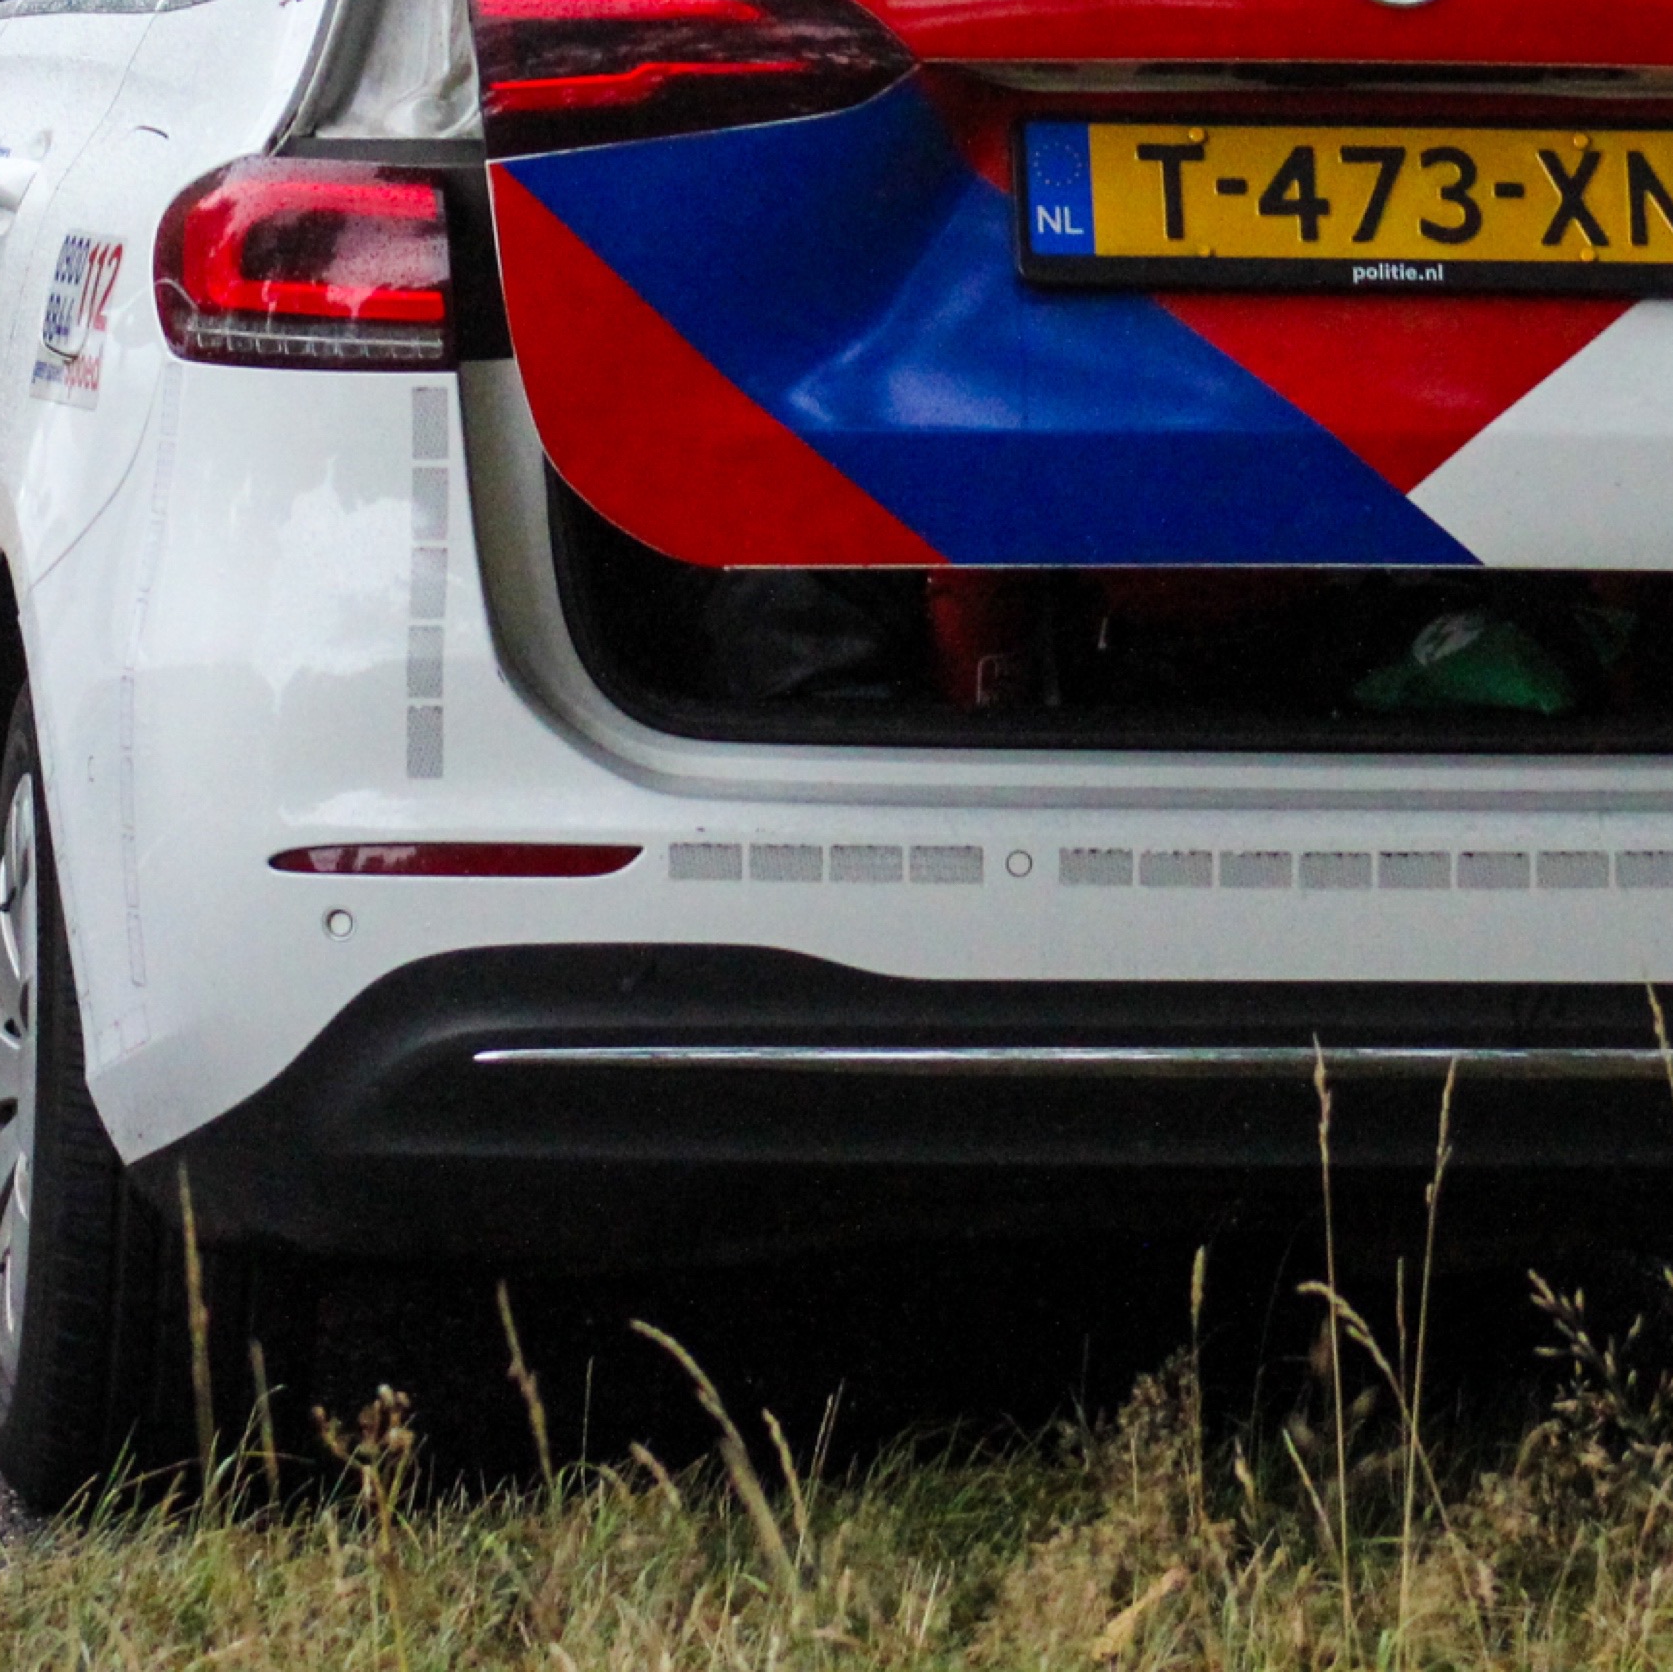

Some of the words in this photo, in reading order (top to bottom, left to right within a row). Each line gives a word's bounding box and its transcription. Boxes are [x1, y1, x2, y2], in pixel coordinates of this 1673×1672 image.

[1036, 206, 1085, 236] NL
[76, 242, 124, 332] 112
[1352, 263, 1445, 284] politie.nl
